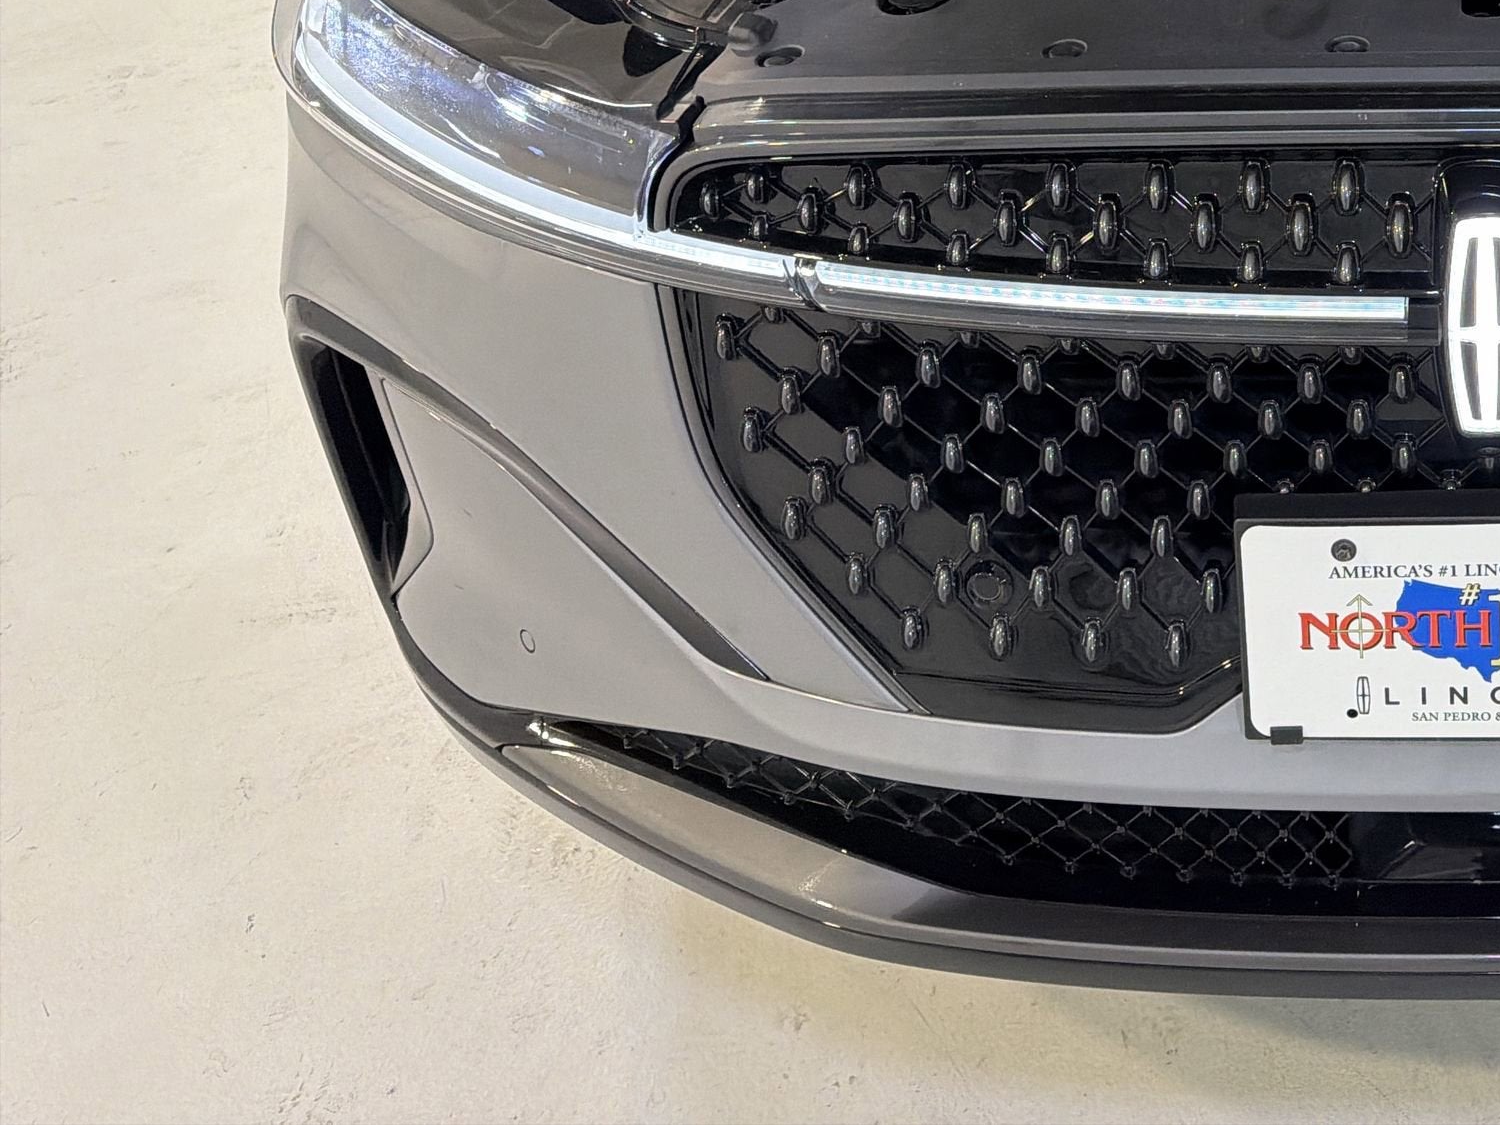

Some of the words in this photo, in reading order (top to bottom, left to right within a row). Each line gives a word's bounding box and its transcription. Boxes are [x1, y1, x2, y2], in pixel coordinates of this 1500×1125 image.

[1329, 564, 1433, 579] AMERICA'S
[1438, 565, 1458, 577] #1
[1298, 609, 1493, 651] NORTH
[1411, 711, 1439, 722] SAN
[1443, 711, 1492, 721] PEDRO
